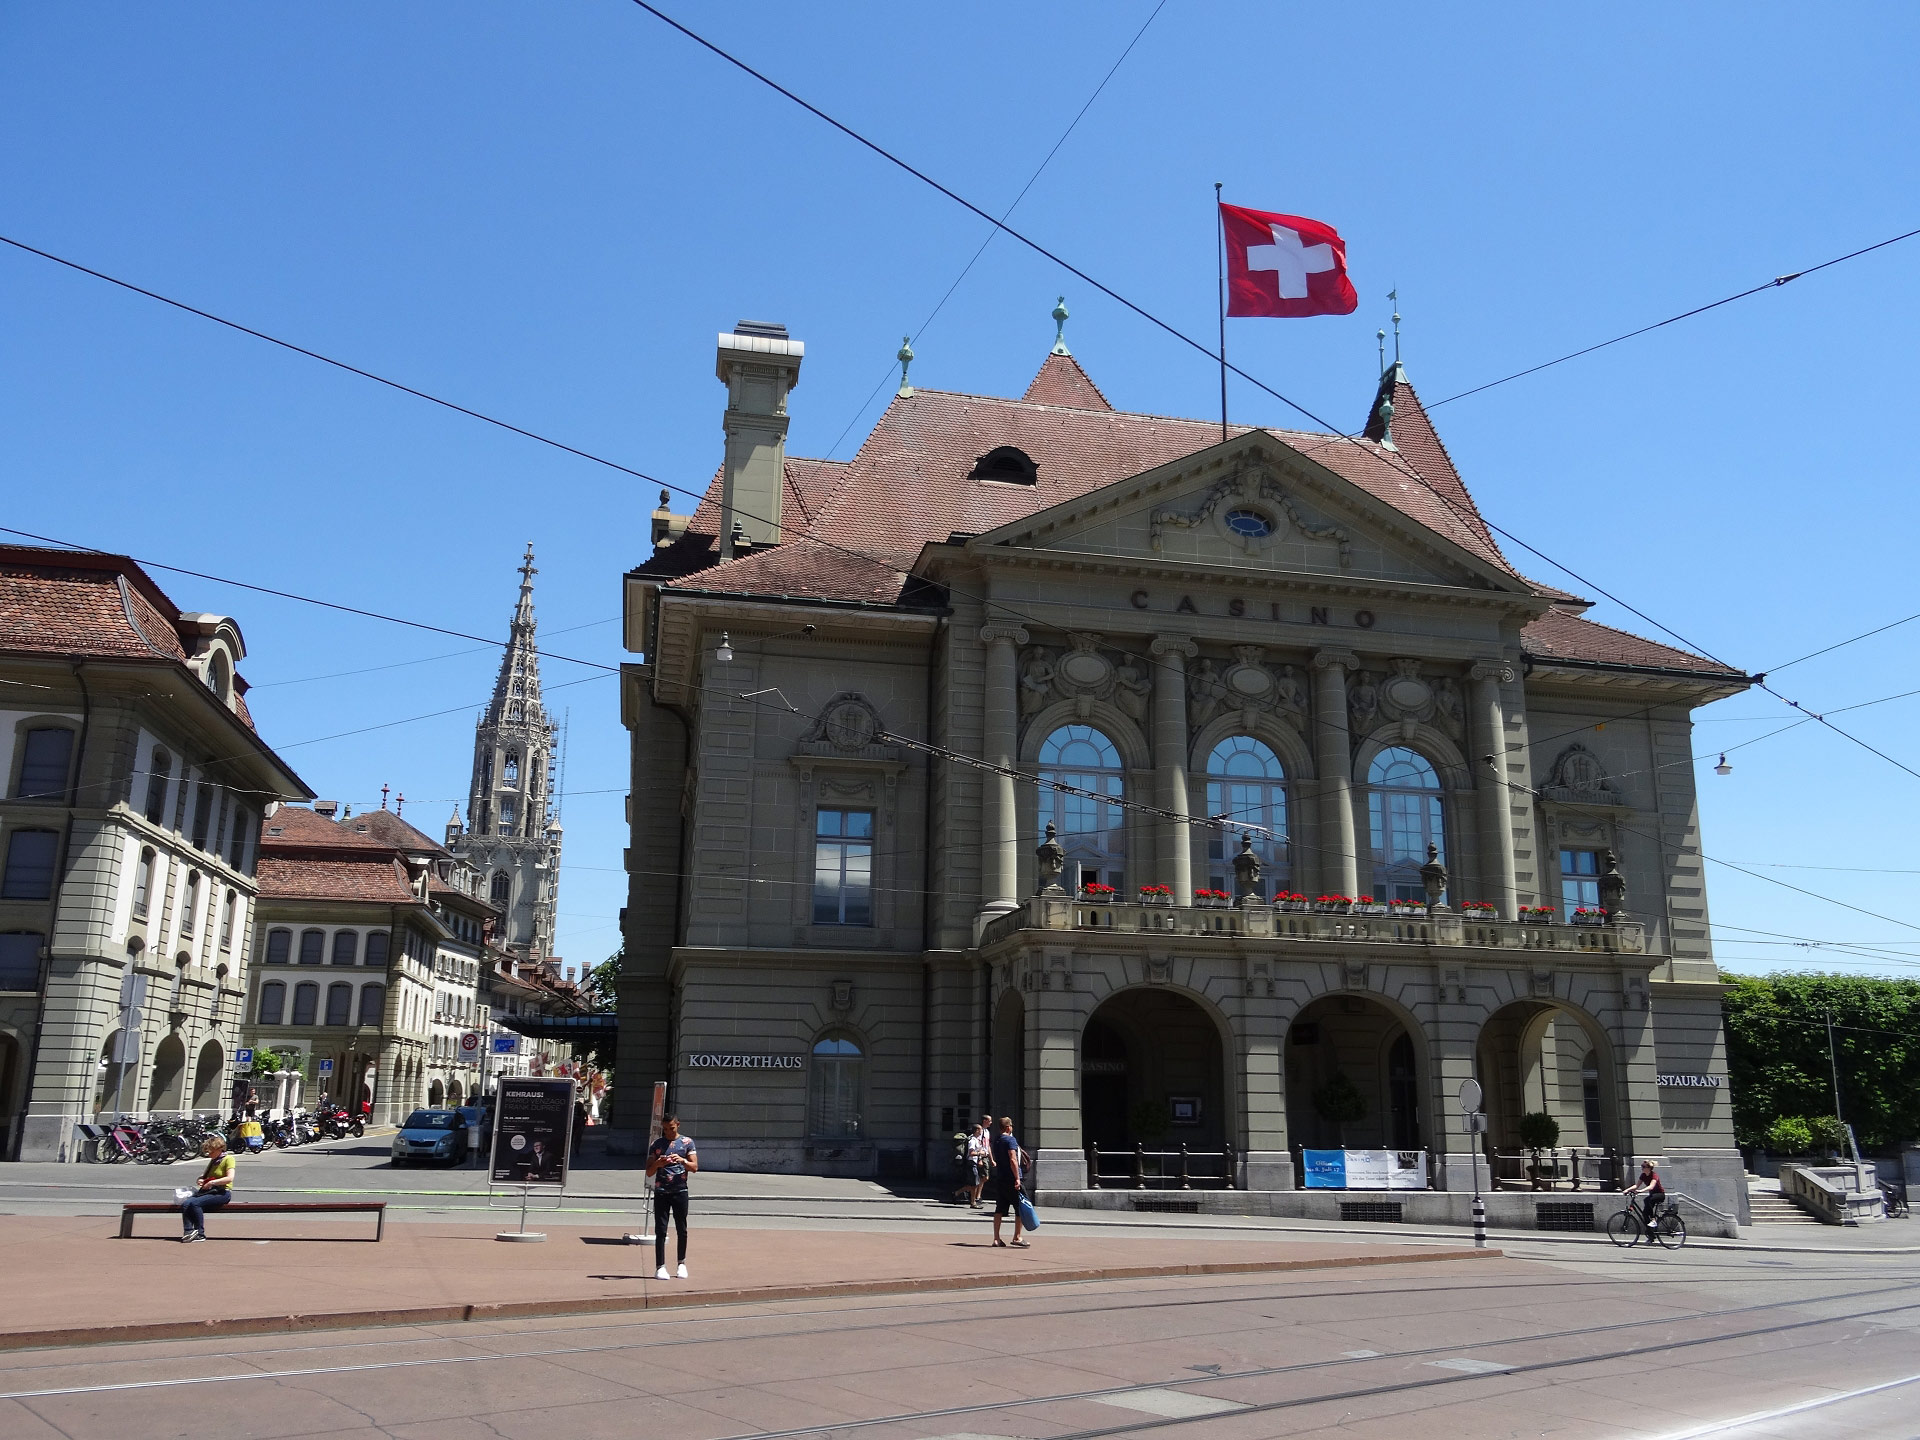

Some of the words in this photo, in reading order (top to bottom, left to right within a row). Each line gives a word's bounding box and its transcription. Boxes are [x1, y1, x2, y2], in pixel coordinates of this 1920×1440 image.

[1130, 590, 1376, 629] CASINO
[240, 1051, 249, 1061] P
[688, 1054, 802, 1069] KONZERTHAUS
[1081, 1062, 1124, 1072] CASINO
